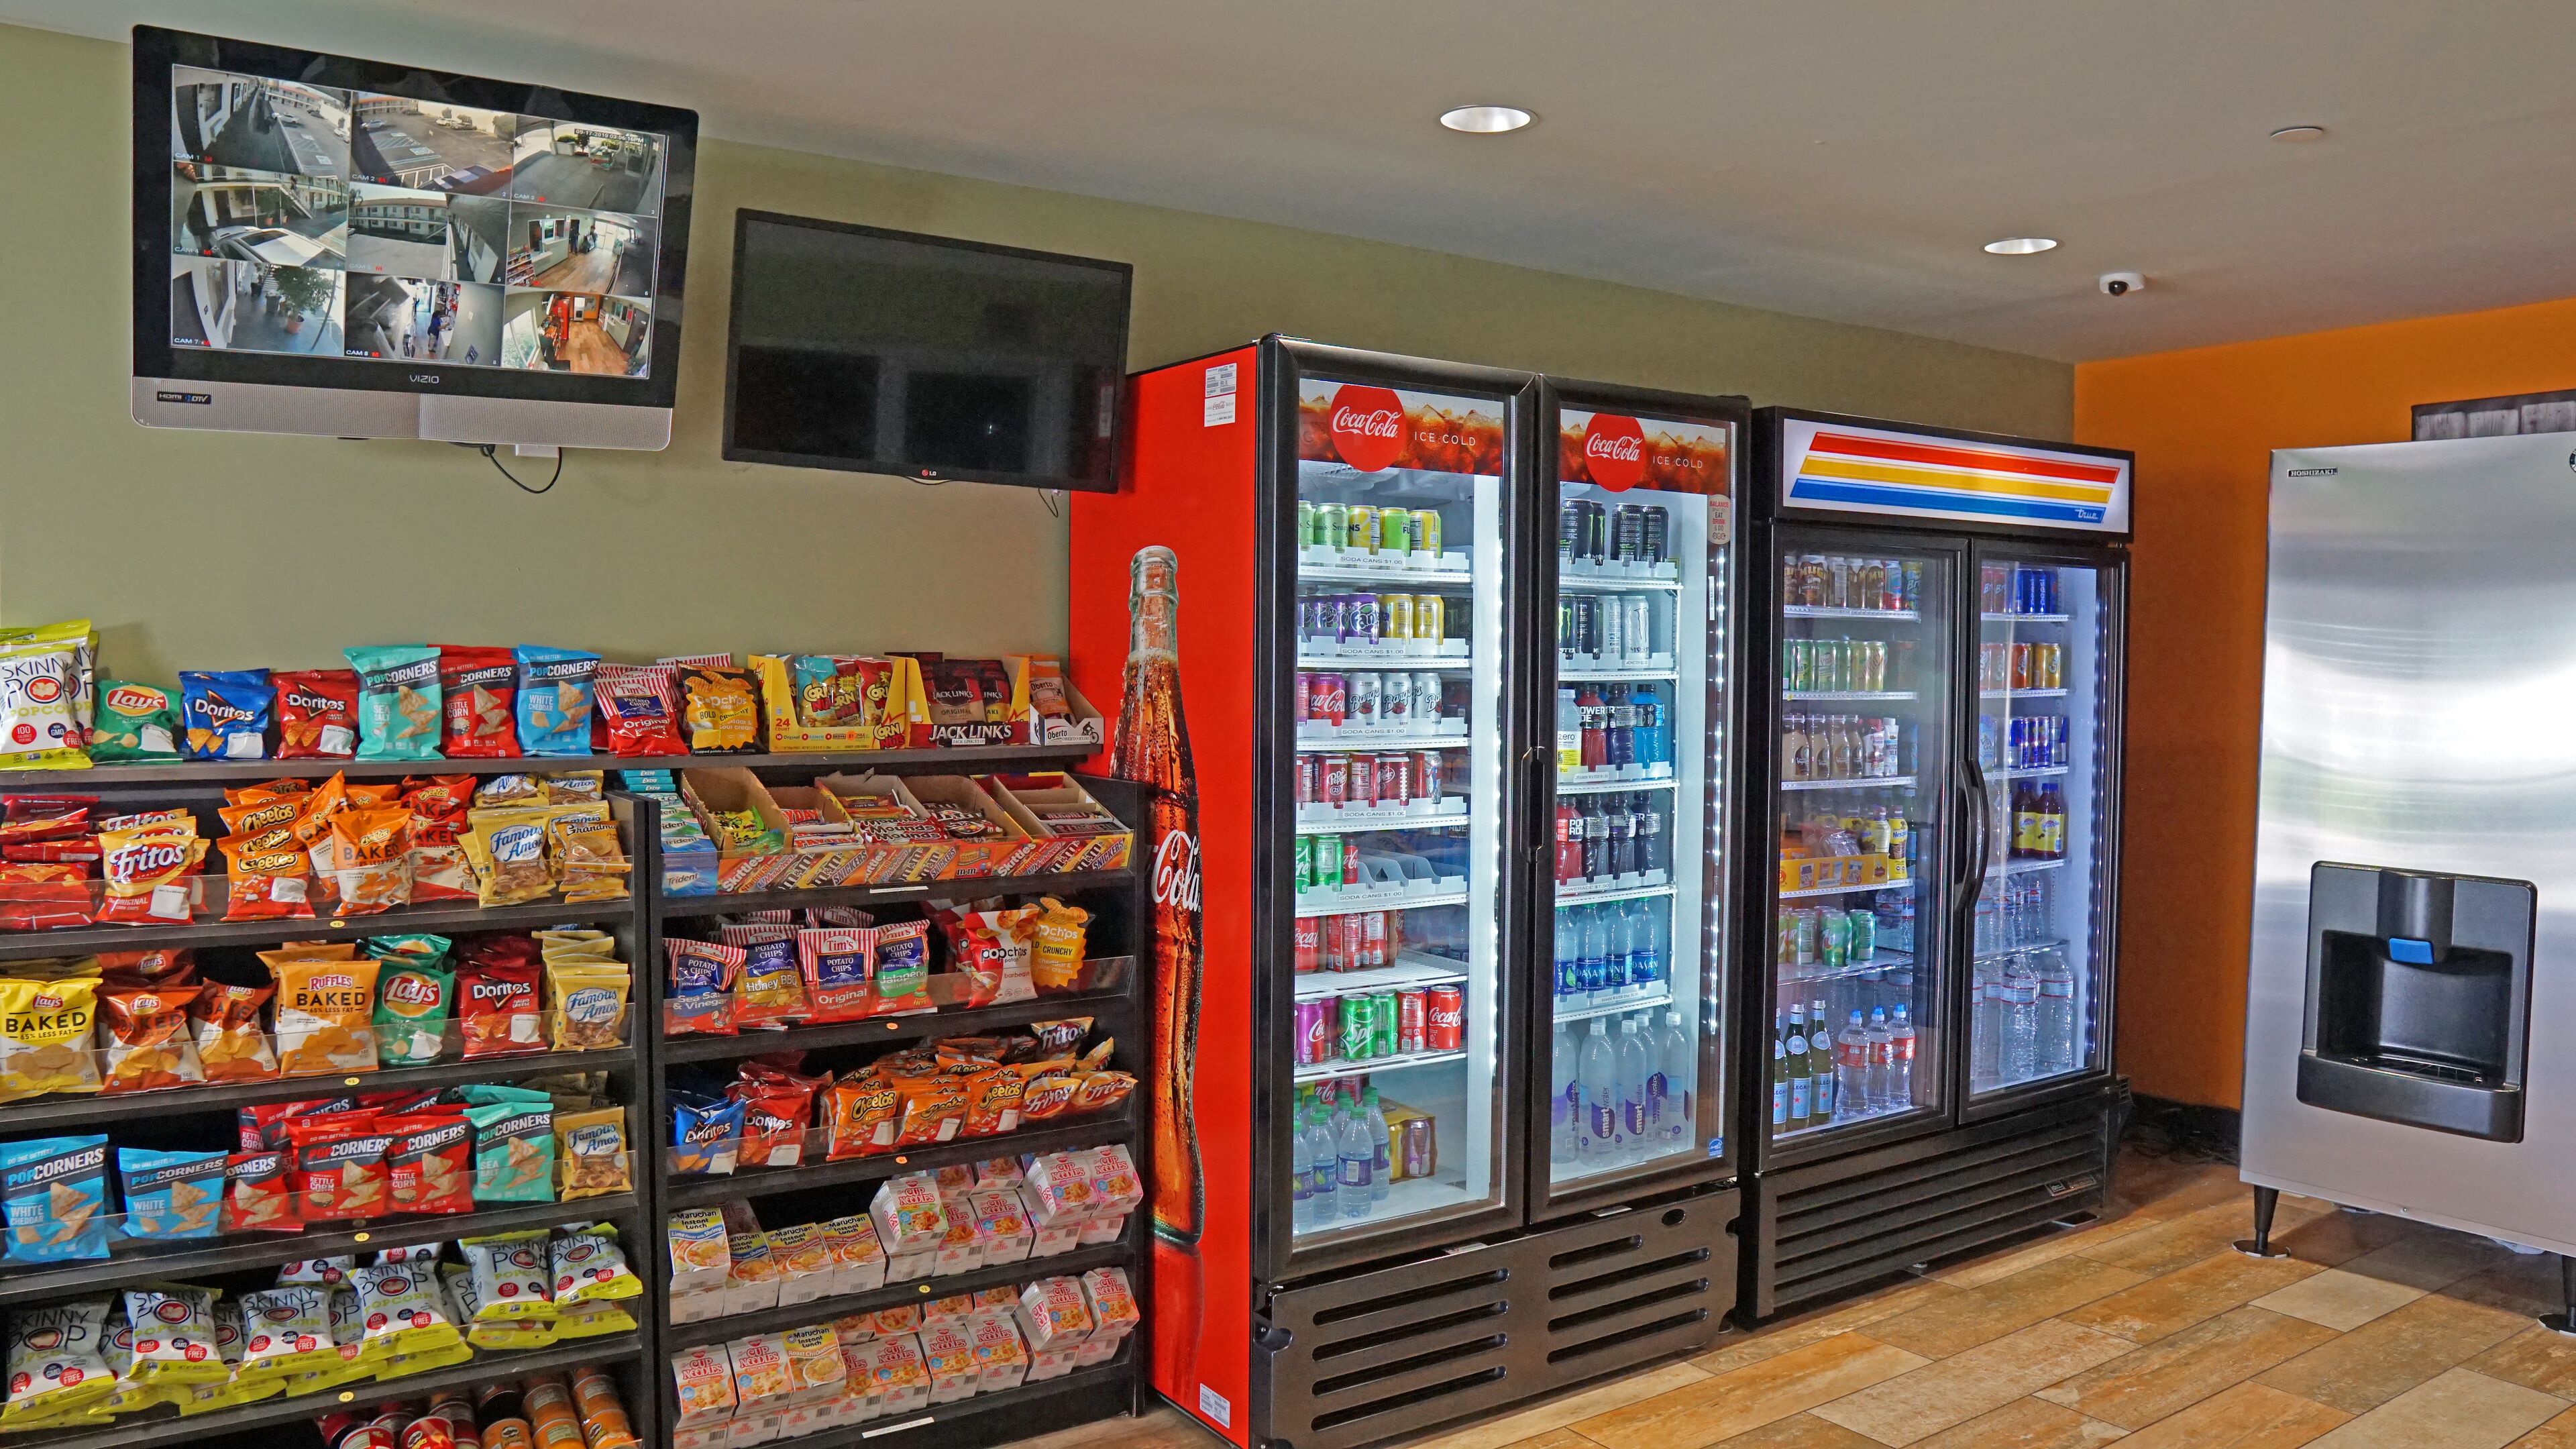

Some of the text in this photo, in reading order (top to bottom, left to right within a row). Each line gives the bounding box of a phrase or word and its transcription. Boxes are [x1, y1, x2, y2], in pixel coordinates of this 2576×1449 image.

[174, 152, 193, 161] CAM
[174, 337, 191, 345] CAM
[409, 374, 439, 384] VIZIO
[1332, 406, 1402, 438] Coca-Cola
[1415, 431, 1476, 446] ICE COLD
[1587, 433, 1642, 462] Coca-Cola
[1653, 455, 1703, 468] ICE COLD
[367, 661, 437, 687] POPCORNERS
[529, 660, 599, 677] POPCORNERS
[621, 686, 647, 695] Tim's
[1031, 682, 1053, 690] Oberto
[110, 690, 166, 709] Lay's
[289, 694, 345, 710] Doritos
[447, 702, 468, 710] KETTLE
[529, 695, 553, 704] WHITE
[195, 698, 255, 721] Doritos
[374, 705, 390, 714] SEA
[447, 708, 468, 718] CORN
[529, 704, 553, 712] CHEDDAR
[374, 712, 390, 722] SALT
[700, 711, 716, 719] BOLD
[624, 718, 669, 729] Original
[775, 718, 790, 727] 24
[873, 722, 900, 739] CORN
[930, 724, 1012, 741] JACK LINK'S
[1047, 730, 1067, 739] Oberto
[241, 805, 296, 833] Cheetos
[870, 825, 935, 833] Mounds
[240, 828, 293, 853] Cheetos
[359, 828, 391, 847] Cheetos
[490, 825, 544, 853] Famous
[665, 837, 698, 846] Trident
[343, 845, 400, 860] BAKED
[504, 840, 542, 861] Amos
[1093, 839, 1125, 870] SNICKERS
[108, 843, 186, 880] Fritos
[239, 853, 298, 872] Cheetos
[930, 847, 956, 879] SNICKERS
[997, 843, 1036, 877] Skittles
[723, 856, 764, 892] Skittles
[833, 851, 867, 885] SNICKERS
[667, 873, 698, 885] Trident
[116, 898, 148, 906] ORIGINAL
[755, 942, 786, 953] POTATO
[826, 941, 854, 951] Tim's
[885, 942, 913, 954] POTATO
[1042, 946, 1073, 956] CRUNCHY
[759, 949, 784, 959] CHIPS
[890, 949, 912, 957] CHIPS
[981, 947, 1027, 963] popchips
[688, 960, 716, 971] POTATO
[690, 967, 712, 977] CHIPS
[310, 975, 353, 991] RUFFLES
[747, 975, 798, 992] Honey BBQ
[880, 970, 927, 984] Jalapeño
[386, 978, 439, 1005] Lay's
[474, 982, 531, 1000] Doritos
[818, 988, 867, 1005] Original
[34, 995, 63, 1008] Lay's
[132, 998, 160, 1010] Lay's
[297, 992, 366, 1006] BAKED
[565, 990, 617, 1012] Famous
[673, 998, 727, 1010] & Vinegar
[678, 994, 700, 1004] Sea
[577, 1005, 619, 1021] Amos
[6, 1012, 87, 1033] BAKED
[1040, 1024, 1085, 1051] Fritos
[1024, 1086, 1071, 1112] Fritos
[851, 1091, 896, 1121] Cheetos
[743, 1116, 793, 1129] Doritos
[568, 1123, 616, 1148] Famous
[686, 1122, 731, 1143] Doritos
[308, 1137, 394, 1160] POPCORNERS
[582, 1136, 619, 1155] Amos
[480, 1161, 498, 1170] SEA
[1099, 1155, 1120, 1165] CUP
[7, 1148, 104, 1187] POPCORNERS
[131, 1159, 225, 1186] POPCORNERS
[1095, 1160, 1128, 1174] NOODLES
[309, 1177, 334, 1185] KETTLE
[310, 1183, 334, 1191] CORN
[392, 1179, 416, 1187] CORN
[905, 1187, 925, 1197] CUP
[133, 1199, 165, 1210] WHITE
[898, 1193, 934, 1205] NOODLES
[11, 1205, 43, 1218] WHITE
[678, 1210, 716, 1220] Maruchan
[11, 1216, 44, 1226] CHEDDAR
[682, 1218, 709, 1226] Instant
[828, 1216, 865, 1229] Maruchan
[704, 1226, 723, 1237] Shrimp
[775, 1225, 813, 1238] Maruchan
[245, 1288, 313, 1308] SKINNY
[414, 1316, 429, 1325] FREE
[794, 1328, 830, 1339] Maruchan
[298, 1338, 315, 1350] FREE
[188, 1350, 205, 1359] FREE
[806, 1347, 830, 1358] Chicken
[690, 1357, 712, 1368] CUP
[683, 1364, 724, 1380] NOODLES
